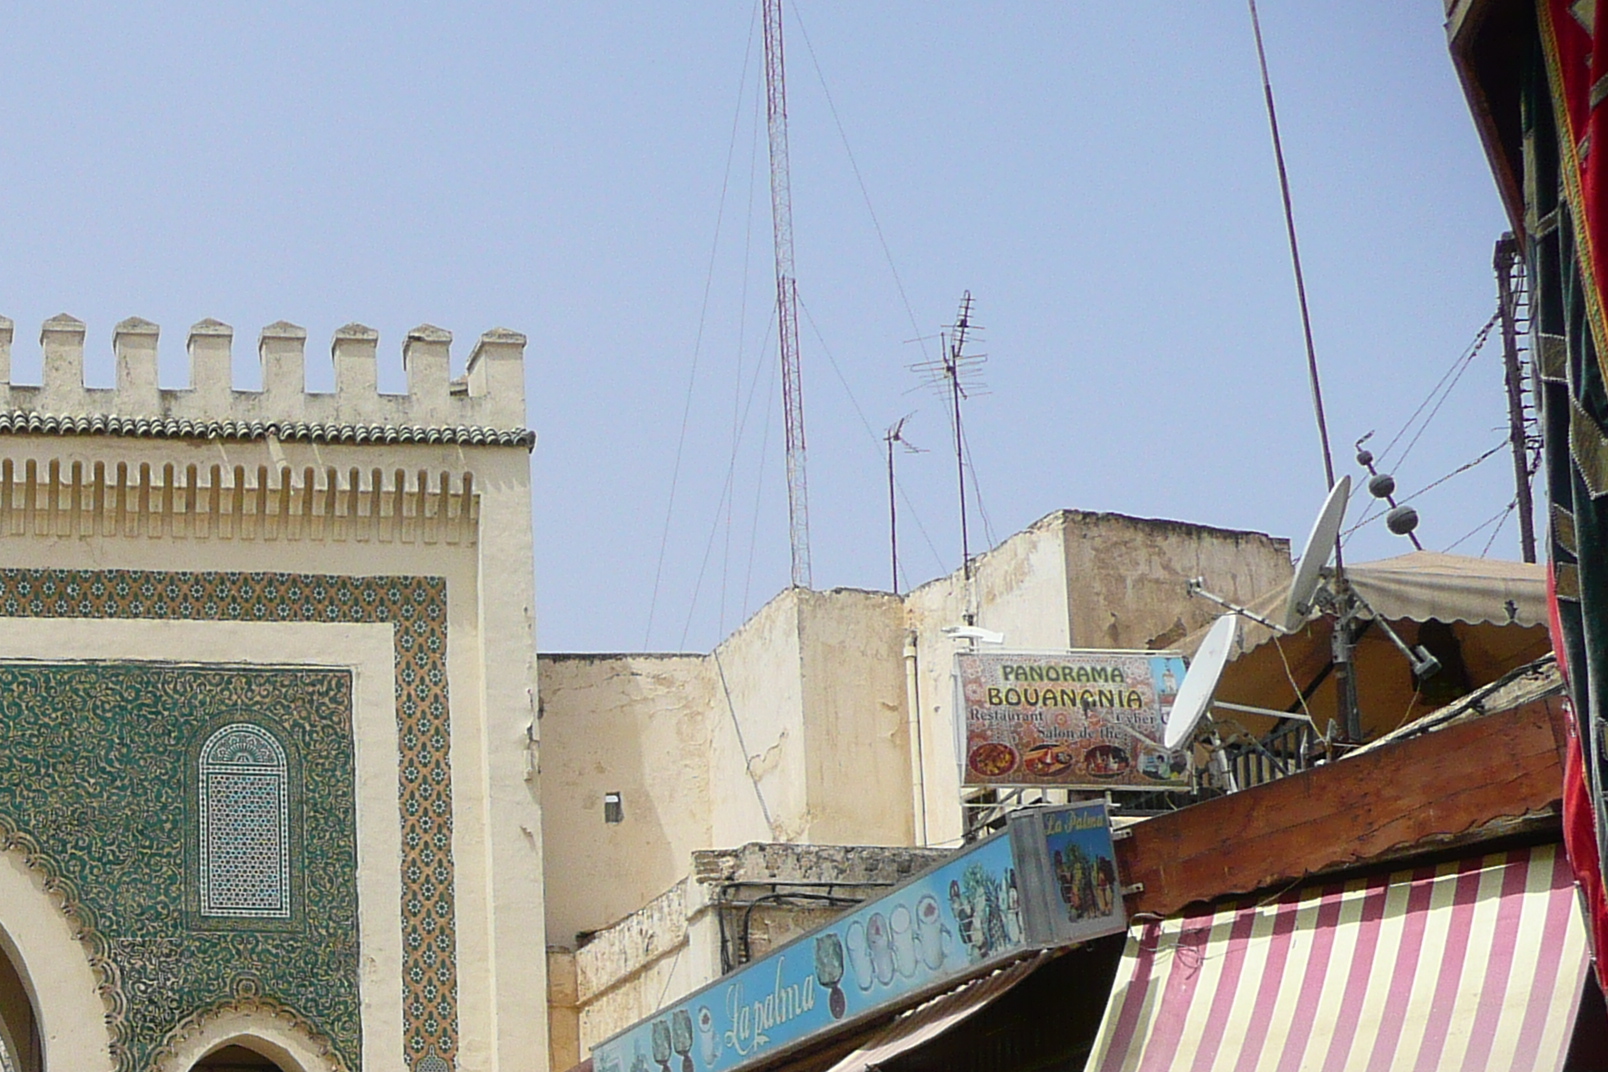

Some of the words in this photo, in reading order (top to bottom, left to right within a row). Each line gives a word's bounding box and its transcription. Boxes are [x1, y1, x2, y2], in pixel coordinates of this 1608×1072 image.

[1002, 665, 1125, 683] PANORAMA
[970, 709, 1044, 722] Restaurant
[1038, 726, 1074, 738] Salon
[1079, 726, 1094, 739] de
[753, 955, 816, 1053] palma
